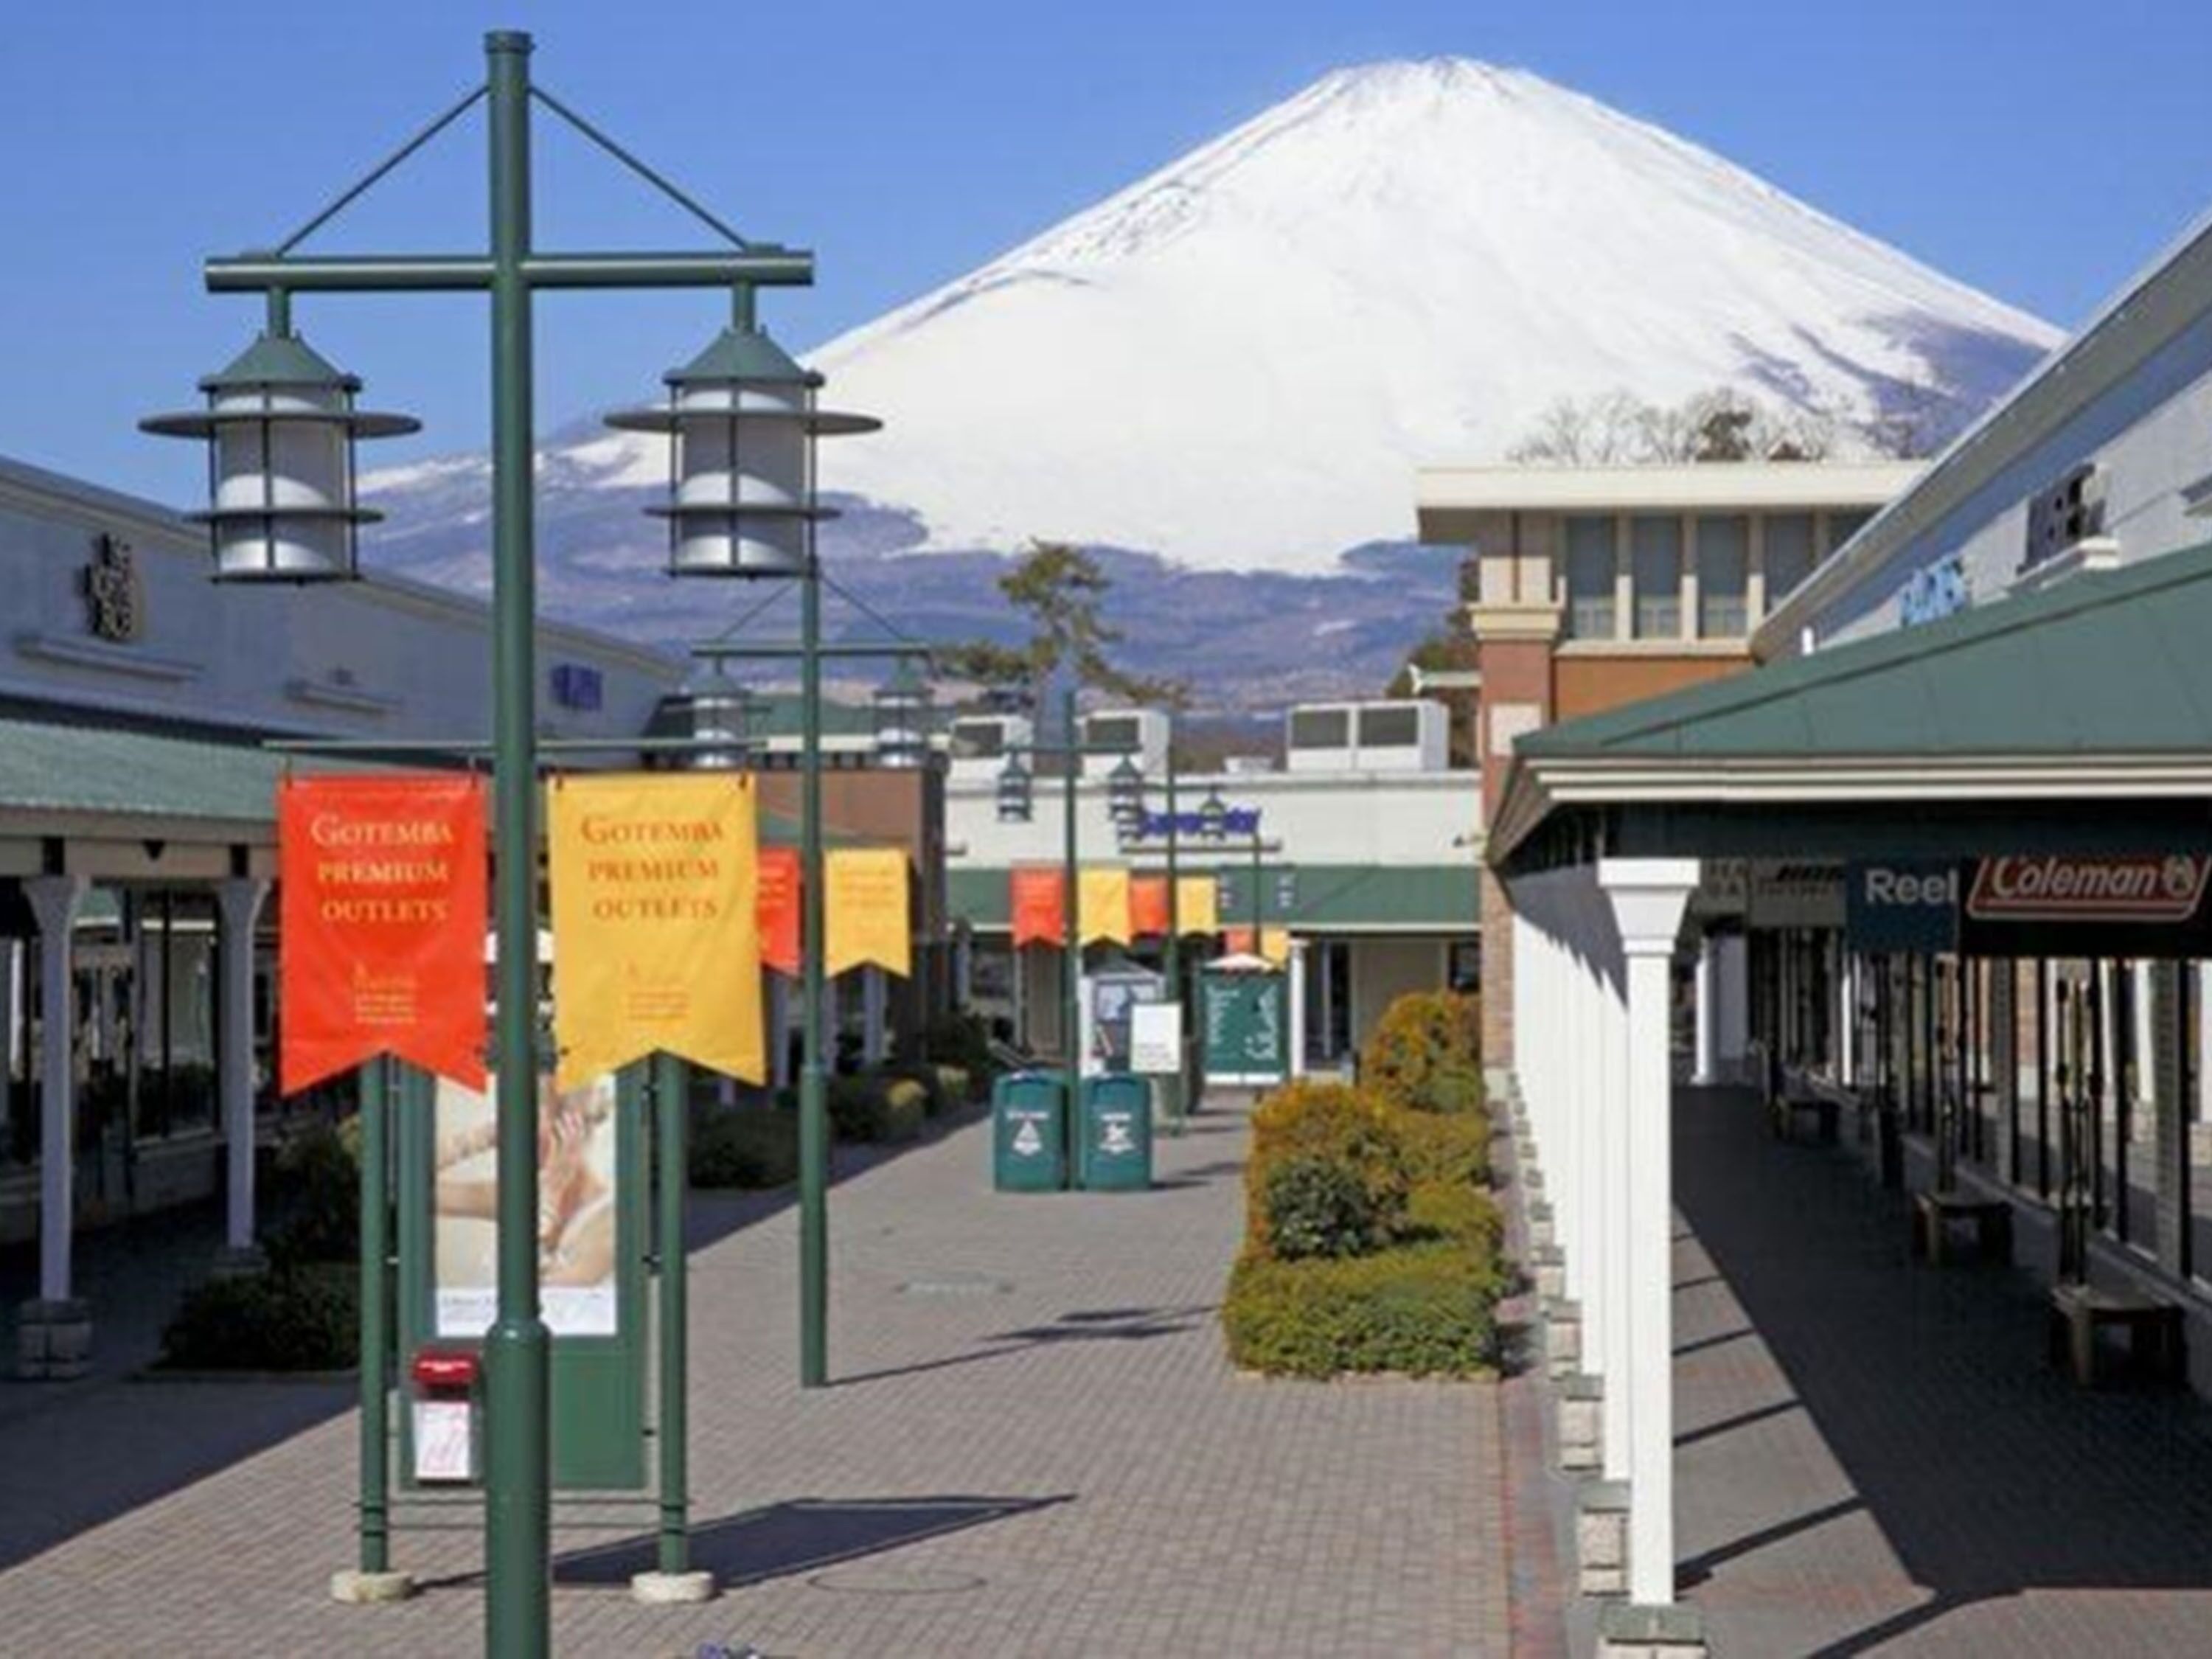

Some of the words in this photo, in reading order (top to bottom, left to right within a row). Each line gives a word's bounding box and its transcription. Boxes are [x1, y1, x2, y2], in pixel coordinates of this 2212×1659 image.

[310, 813, 452, 846] GOTEMBA
[581, 815, 723, 844] GOTEMBA
[318, 862, 448, 883] PREMIUM
[589, 860, 719, 882] PREMIUM
[1994, 856, 2158, 899] Coleman
[321, 899, 446, 922] OUTLETS
[593, 899, 717, 919] OUTLETS
